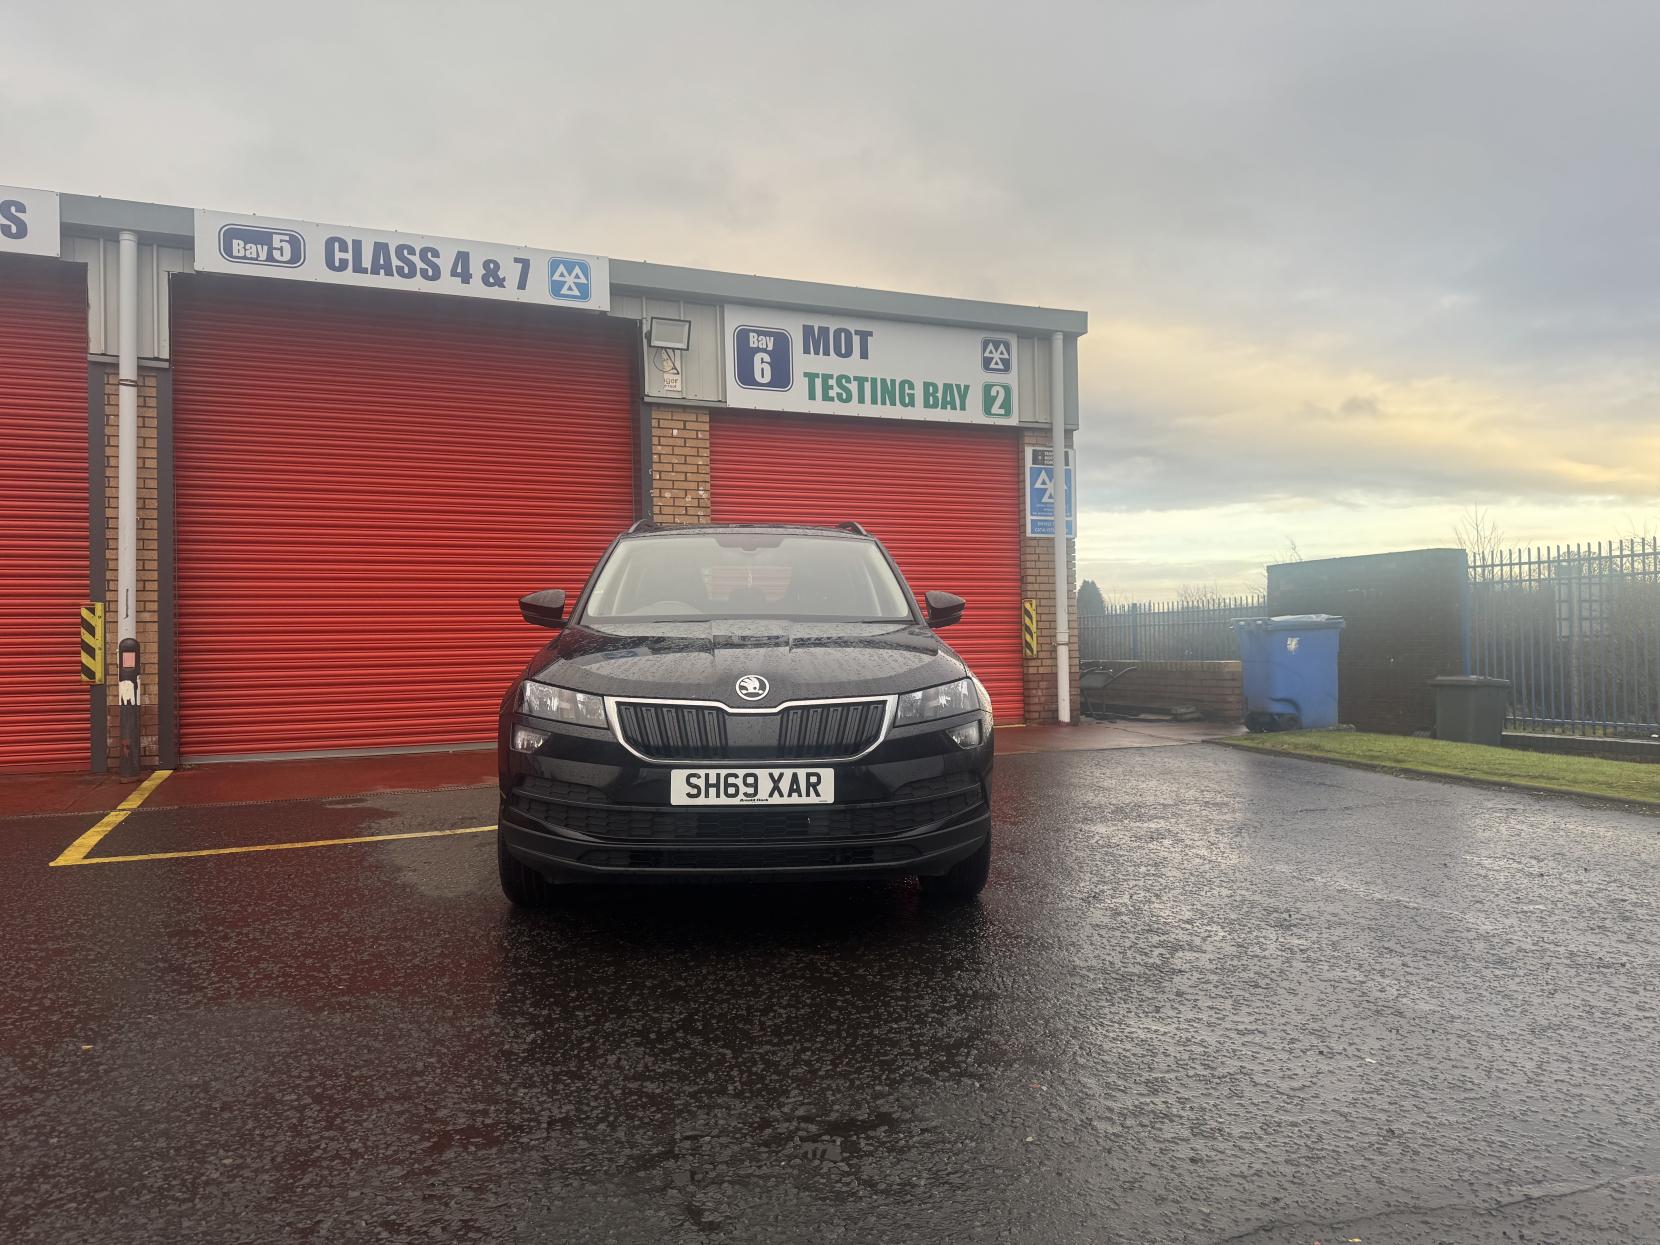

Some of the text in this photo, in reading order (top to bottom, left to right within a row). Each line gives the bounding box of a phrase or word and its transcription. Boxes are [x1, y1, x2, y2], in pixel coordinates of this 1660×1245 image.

[0, 199, 28, 240] S
[232, 234, 292, 262] Bay 5
[324, 236, 531, 291] CLASS 4 & 7
[749, 332, 774, 350] Bay
[802, 324, 873, 360] MOT
[753, 352, 772, 384] 6
[803, 371, 970, 411] TESTING BAY
[990, 385, 1006, 415] 2
[685, 772, 822, 799] SH69 XAR
